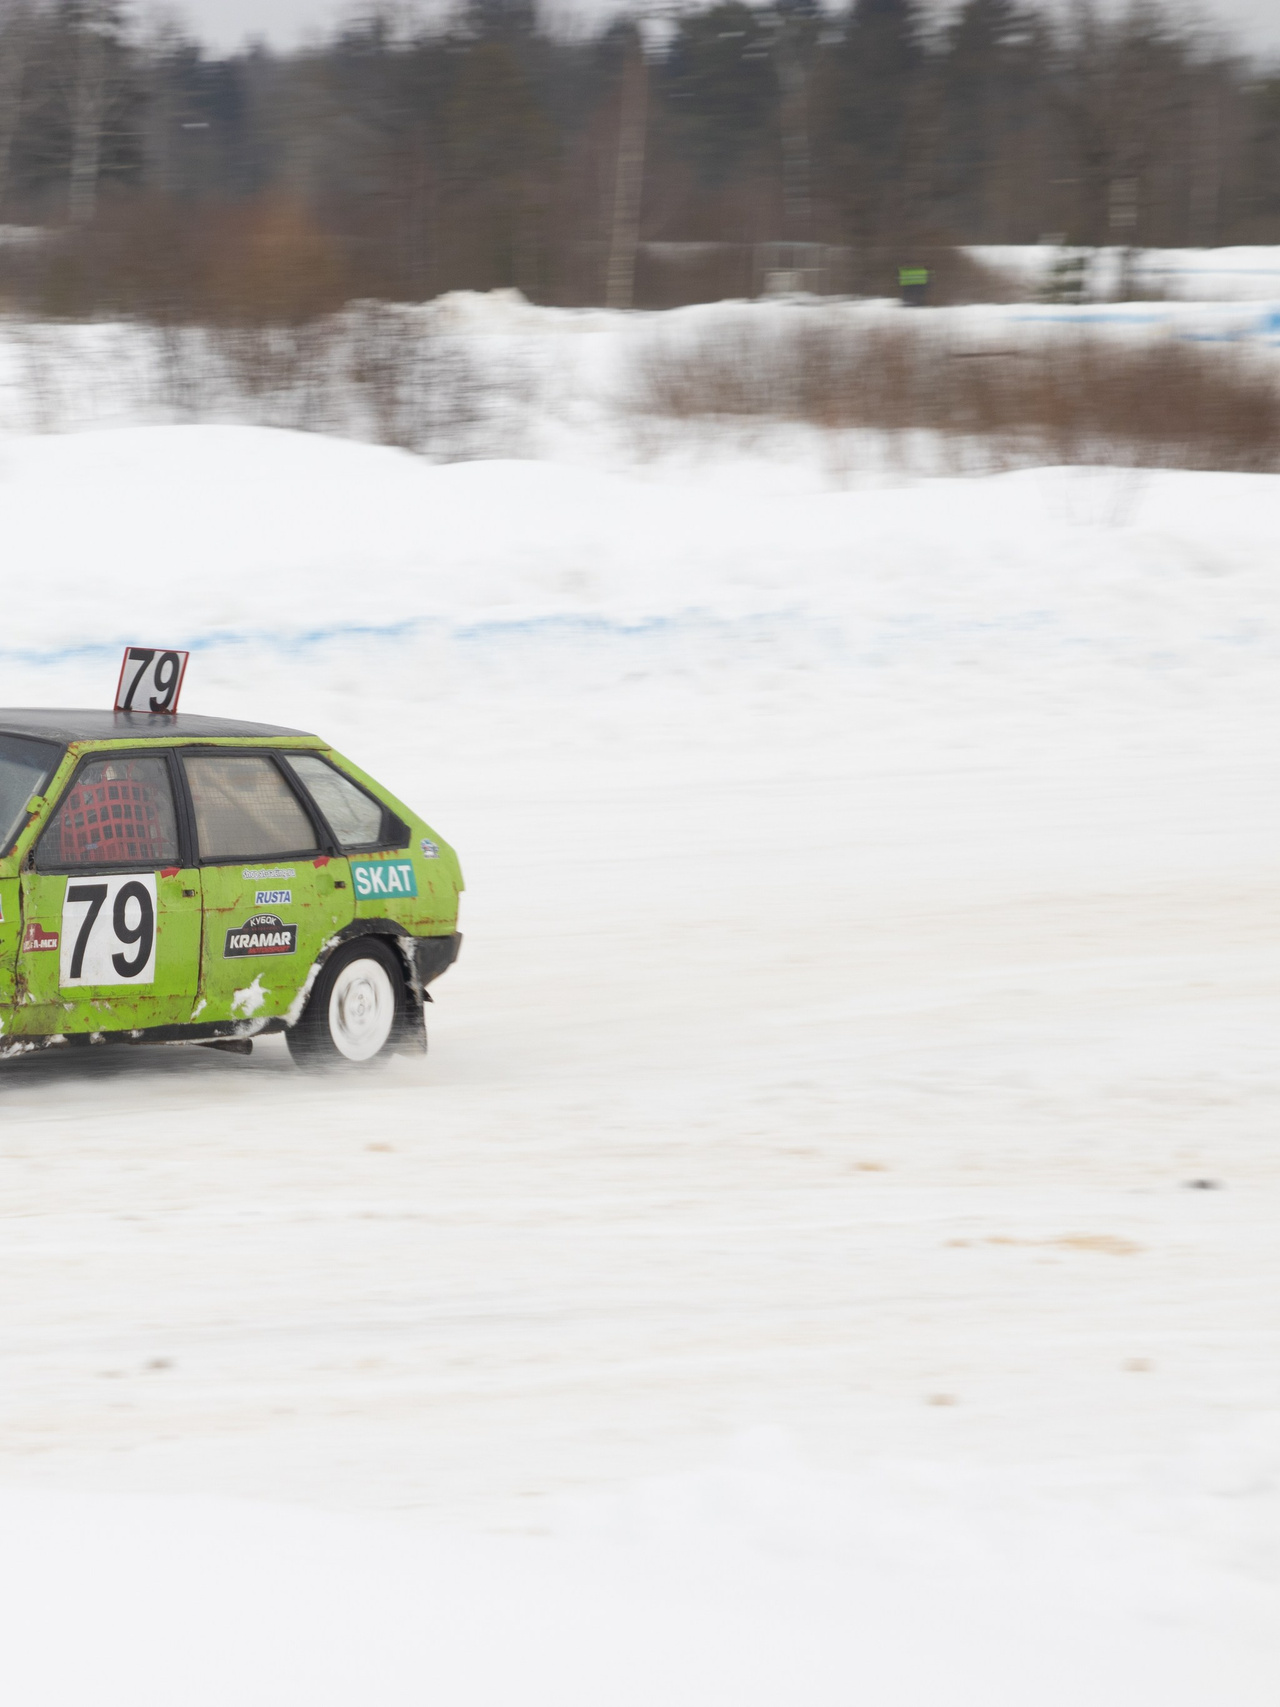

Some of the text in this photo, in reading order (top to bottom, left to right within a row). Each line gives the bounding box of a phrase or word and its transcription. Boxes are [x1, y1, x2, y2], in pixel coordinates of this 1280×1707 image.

[124, 649, 180, 712] 79
[355, 865, 411, 894] SKAT
[256, 891, 291, 903] RUSTA
[67, 881, 154, 978] 79
[250, 916, 277, 926] КУБОК
[230, 932, 291, 949] KRAMAR
